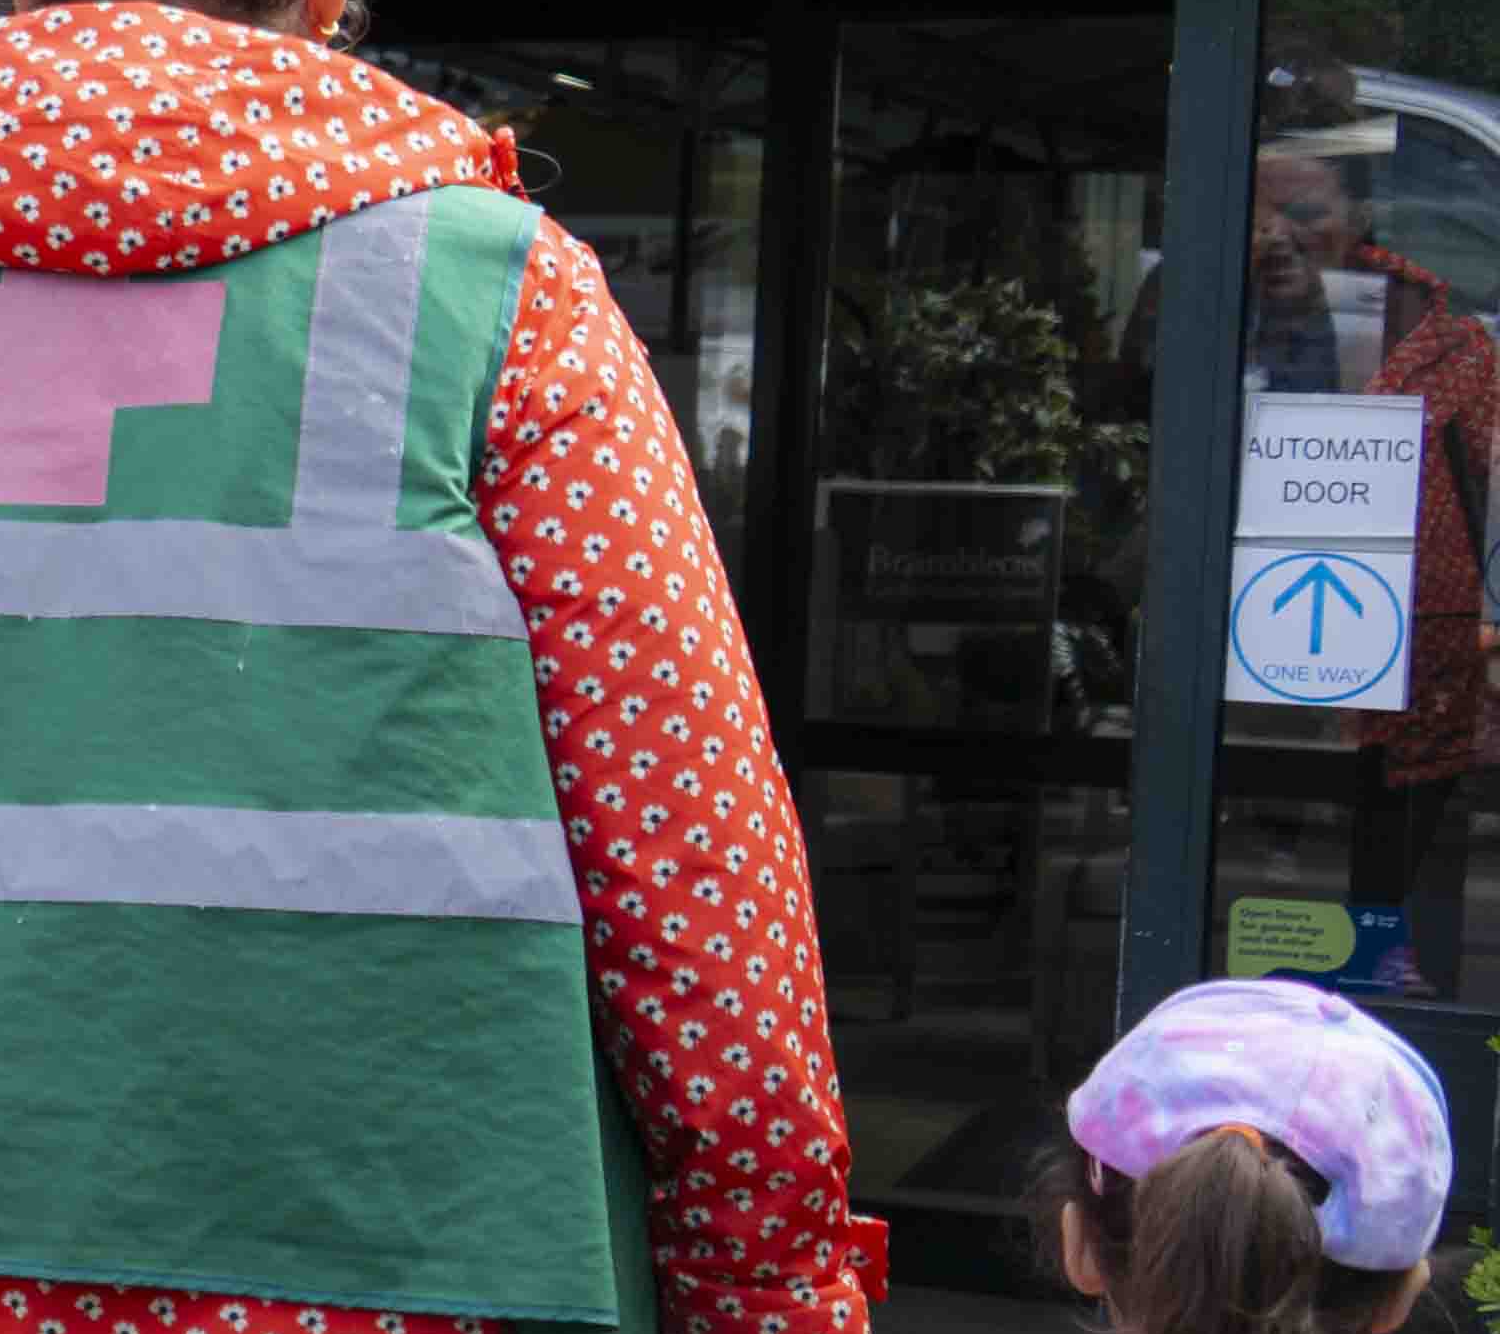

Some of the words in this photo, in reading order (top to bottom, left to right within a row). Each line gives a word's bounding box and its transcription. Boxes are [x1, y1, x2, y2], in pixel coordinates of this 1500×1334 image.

[1247, 436, 1416, 464] AUTOMATIC
[1281, 479, 1372, 507] DOOR
[1261, 664, 1311, 684] ONE
[1316, 664, 1369, 686] WAY
